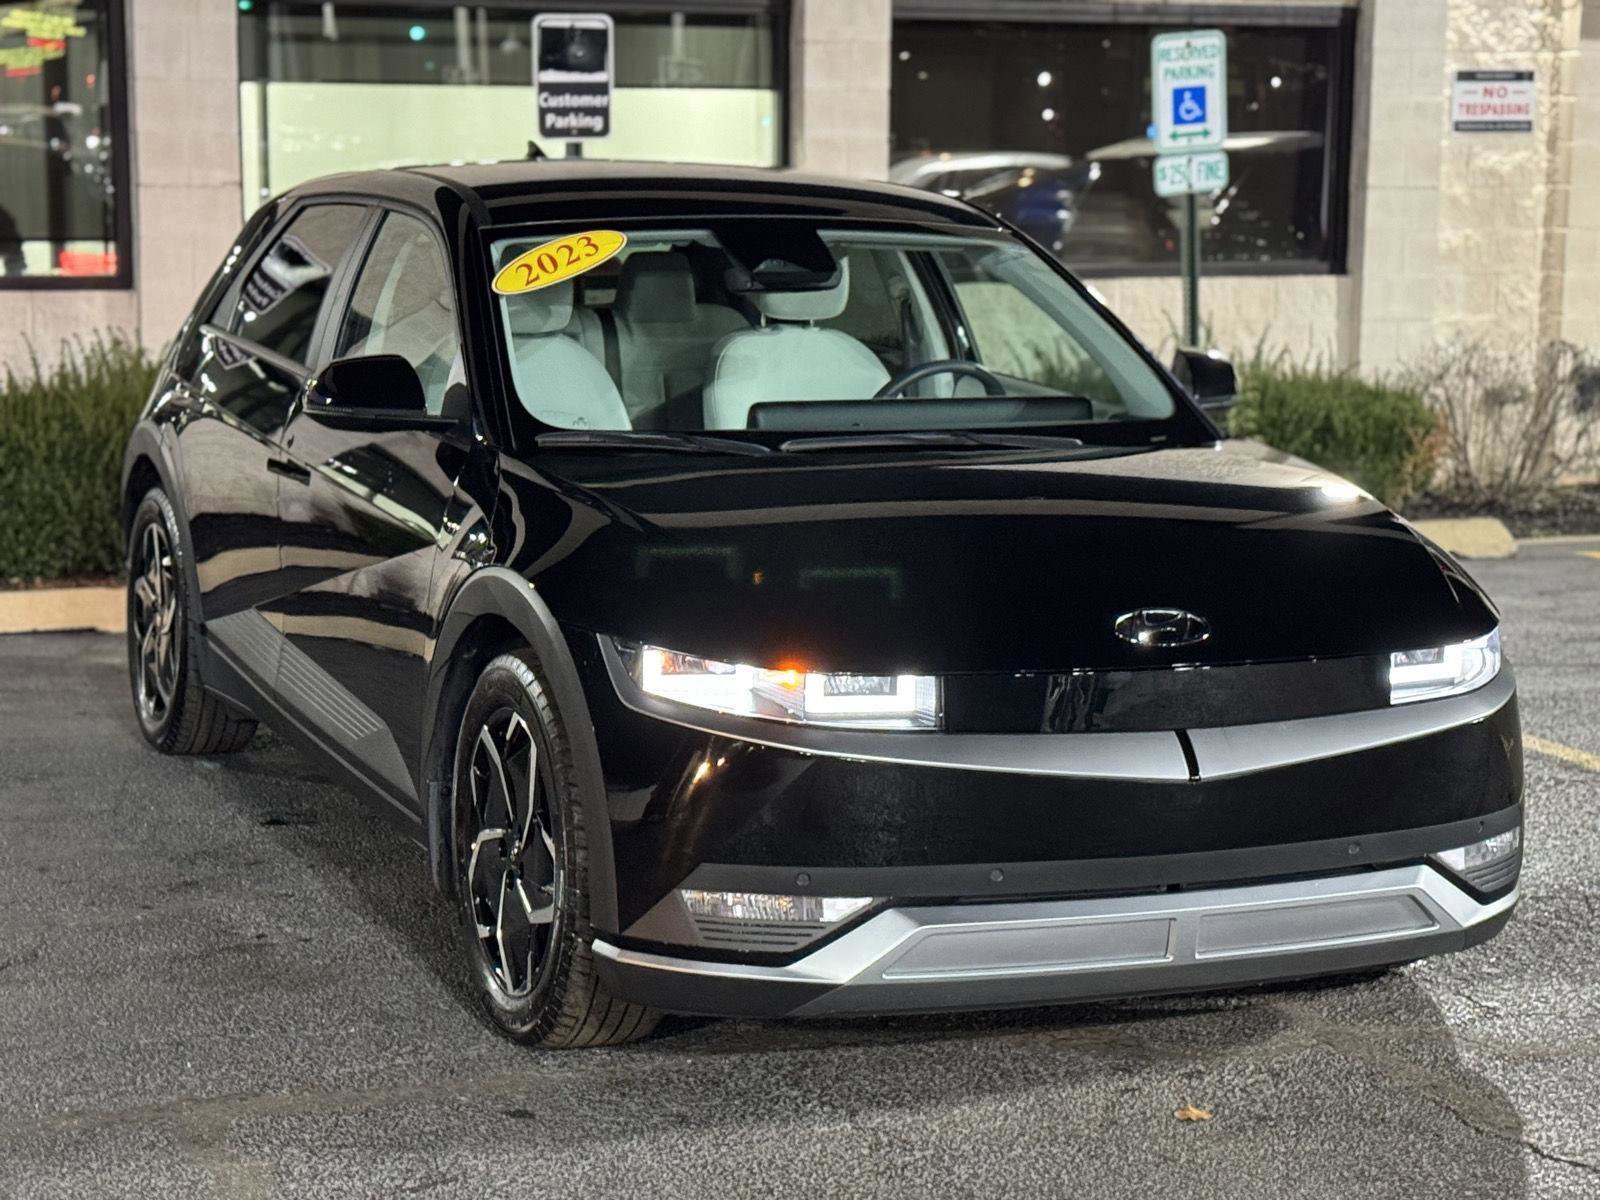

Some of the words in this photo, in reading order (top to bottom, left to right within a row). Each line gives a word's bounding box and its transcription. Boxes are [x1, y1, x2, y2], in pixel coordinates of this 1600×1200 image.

[1158, 45, 1221, 61] RESERVED
[1164, 64, 1215, 80] PARKING
[540, 92, 608, 108] Customer
[1483, 86, 1507, 98] NO
[1458, 103, 1529, 115] TRESPASSING
[545, 112, 604, 132] Parking
[1198, 160, 1226, 181] FINE
[516, 236, 599, 286] 2023
